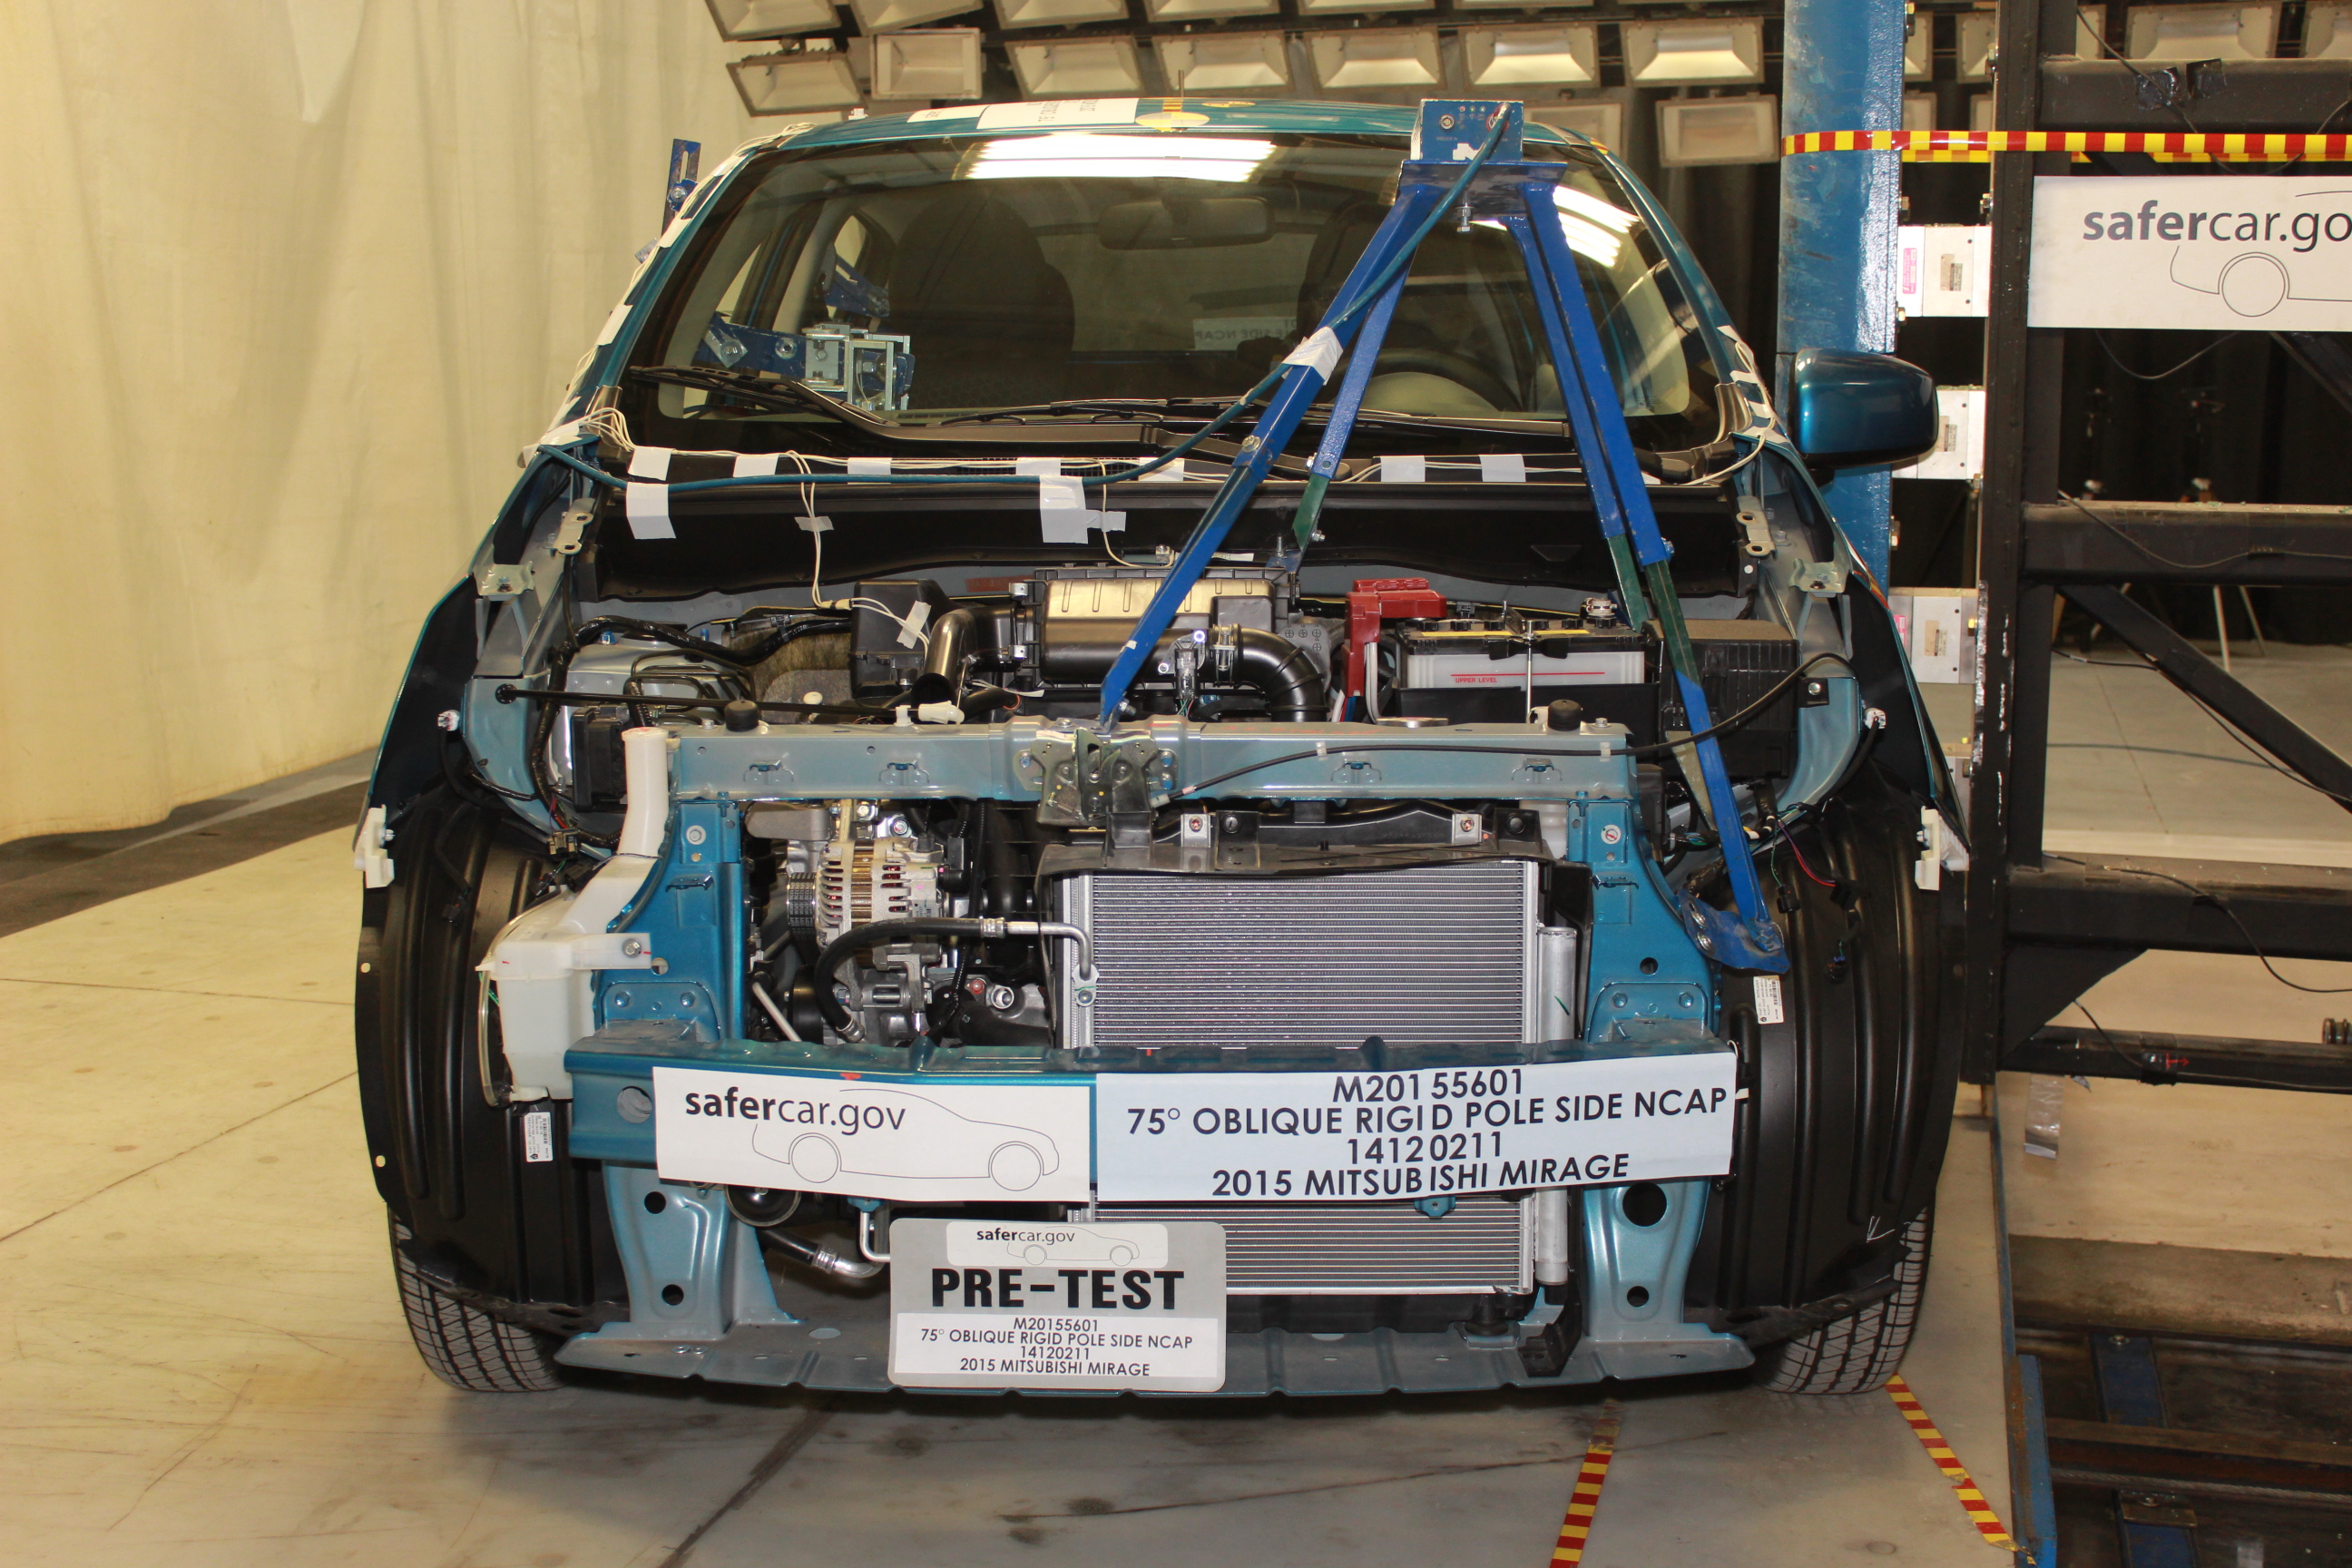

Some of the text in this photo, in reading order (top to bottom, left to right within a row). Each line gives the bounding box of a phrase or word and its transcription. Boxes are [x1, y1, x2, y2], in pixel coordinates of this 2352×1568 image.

[1332, 1068, 1522, 1102] M20155601
[685, 1085, 906, 1136] safercar.gov
[1192, 1107, 1342, 1136] OBLIQUE
[1357, 1103, 1453, 1133] RIGID
[1465, 1097, 1544, 1128] POLE
[1554, 1093, 1622, 1122] SIDE
[1634, 1087, 1727, 1118] NCAP
[1348, 1131, 1501, 1165] 14120211
[1212, 1153, 1629, 1197] 2015 MITSUBISHI MIRAGE
[976, 1227, 1075, 1245] safercar.gov
[931, 1268, 1185, 1310] PRE-TEST
[949, 1329, 1014, 1344] OBLIQUE
[1020, 1331, 1063, 1345] RIGID
[1068, 1333, 1105, 1347] POLE
[1111, 1334, 1142, 1348] SIDE
[1148, 1336, 1192, 1348] NCAP
[1014, 1318, 1097, 1332] M20155601
[960, 1357, 1150, 1377] 2015 MITSUBISHI MIRAGE
[1021, 1346, 1089, 1360] 14120211
